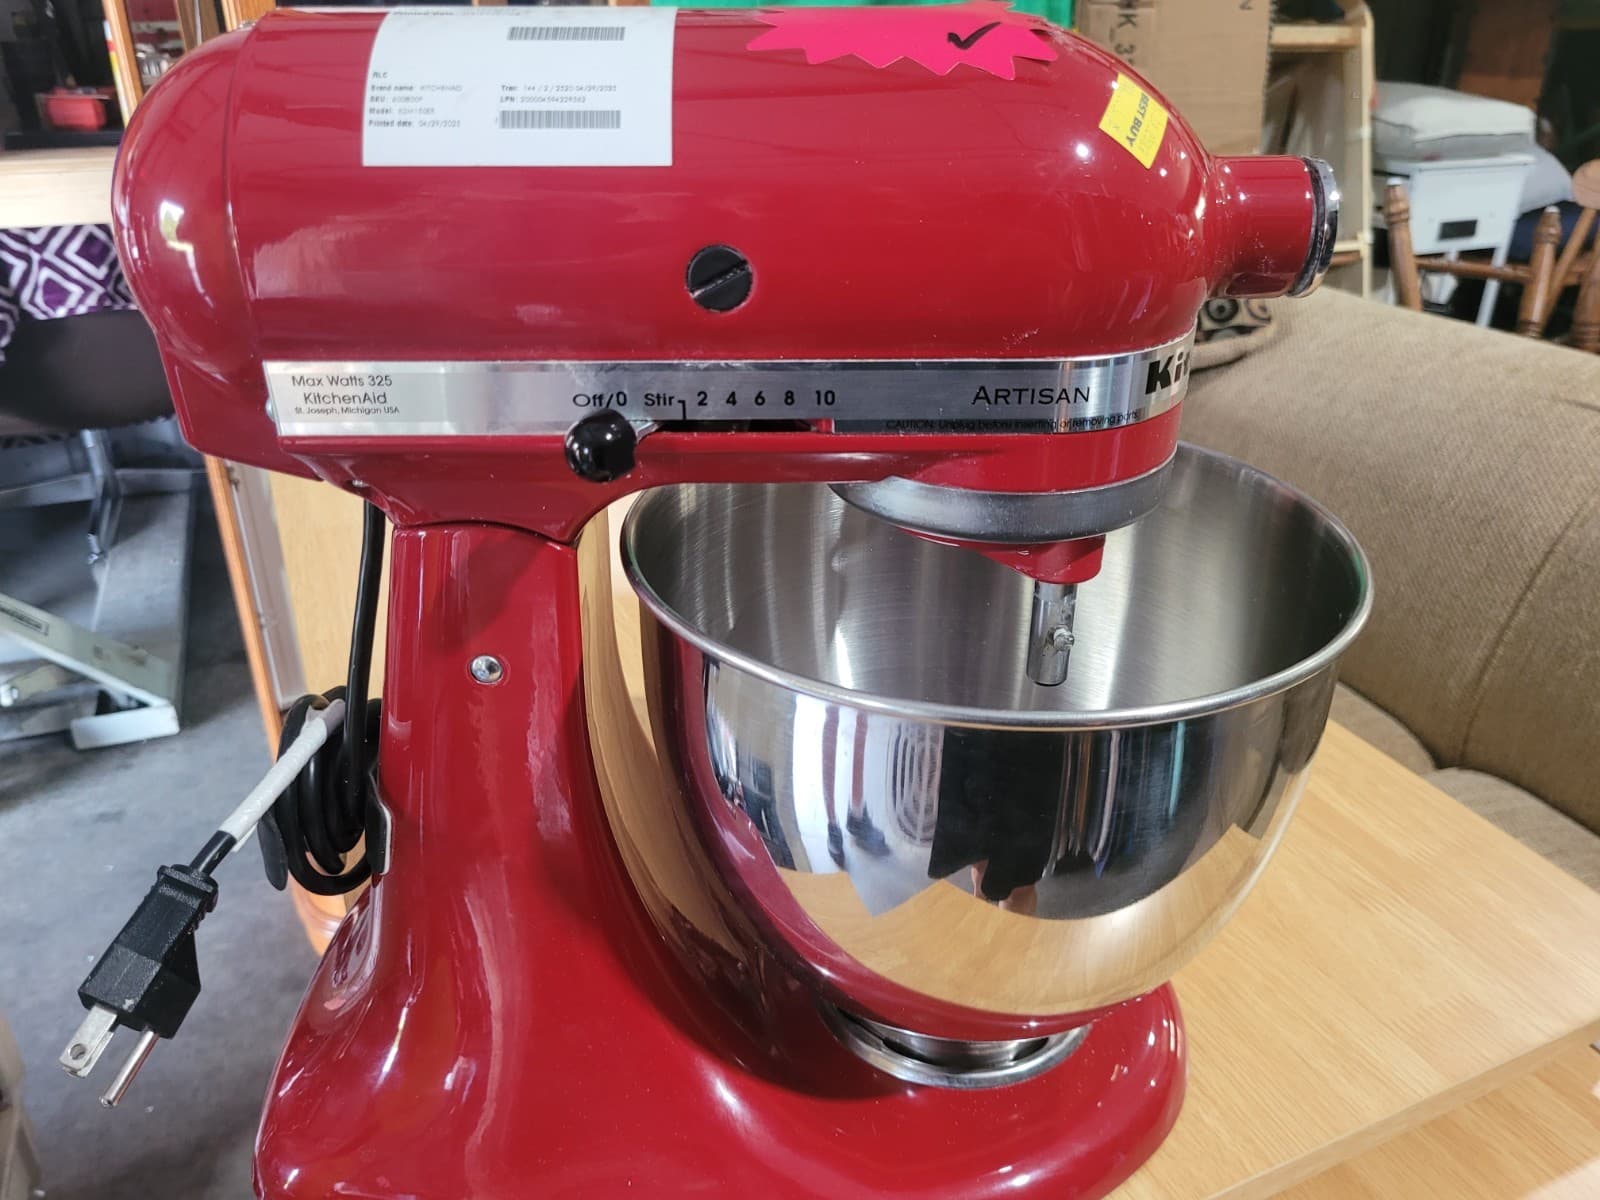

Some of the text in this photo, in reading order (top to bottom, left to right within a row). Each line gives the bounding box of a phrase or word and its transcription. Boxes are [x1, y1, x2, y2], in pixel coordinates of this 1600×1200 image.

[369, 120, 394, 128] Printed
[1126, 116, 1142, 147] BUY
[291, 375, 393, 387] Max Watts 325
[304, 392, 387, 404] KitchenAid
[572, 390, 836, 409] Off/0 Stir 2 4 6 8 10
[971, 386, 1090, 406] ARTISAN
[307, 406, 340, 416] Joseph,
[341, 406, 382, 416] Michigan
[1061, 420, 1071, 428] or
[1072, 415, 1116, 429] removing
